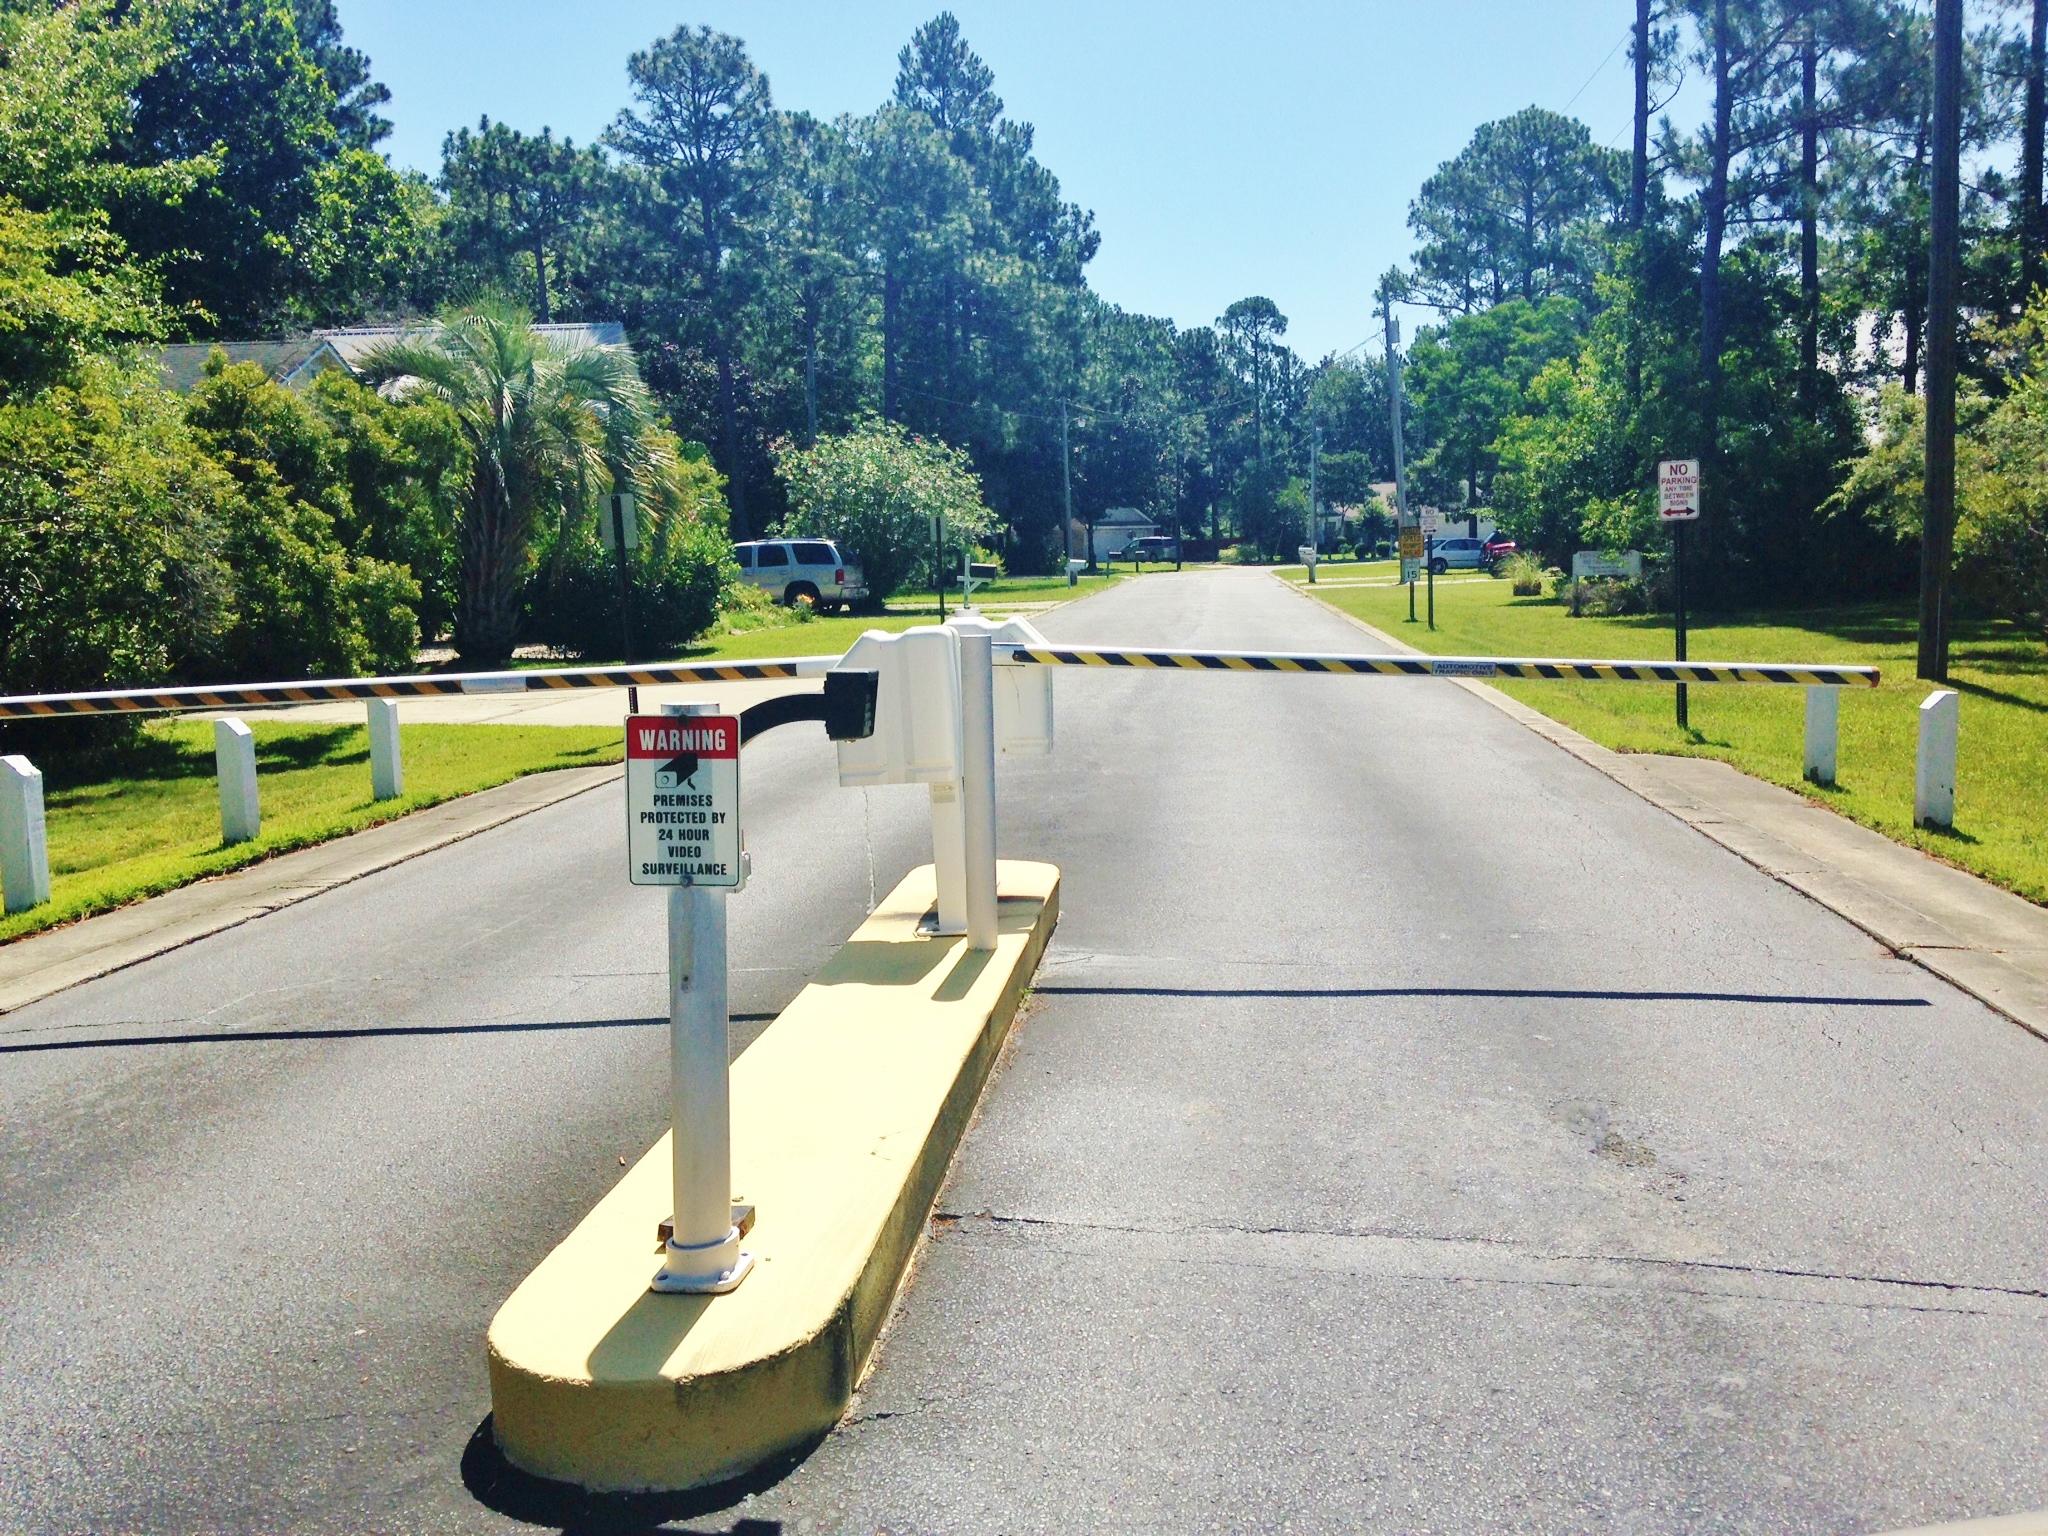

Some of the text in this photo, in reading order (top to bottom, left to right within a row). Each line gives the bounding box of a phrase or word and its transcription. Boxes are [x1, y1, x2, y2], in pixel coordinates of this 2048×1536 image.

[1669, 463, 1688, 476] NO
[1661, 475, 1697, 485] PARKING
[638, 728, 726, 751] WARNING
[653, 794, 713, 807] PREMISES
[640, 811, 726, 824] PROTECTED BY
[658, 828, 710, 841] 24 HOUR
[668, 845, 701, 858] VIDEO
[642, 863, 727, 876] SURVEILLANCE
